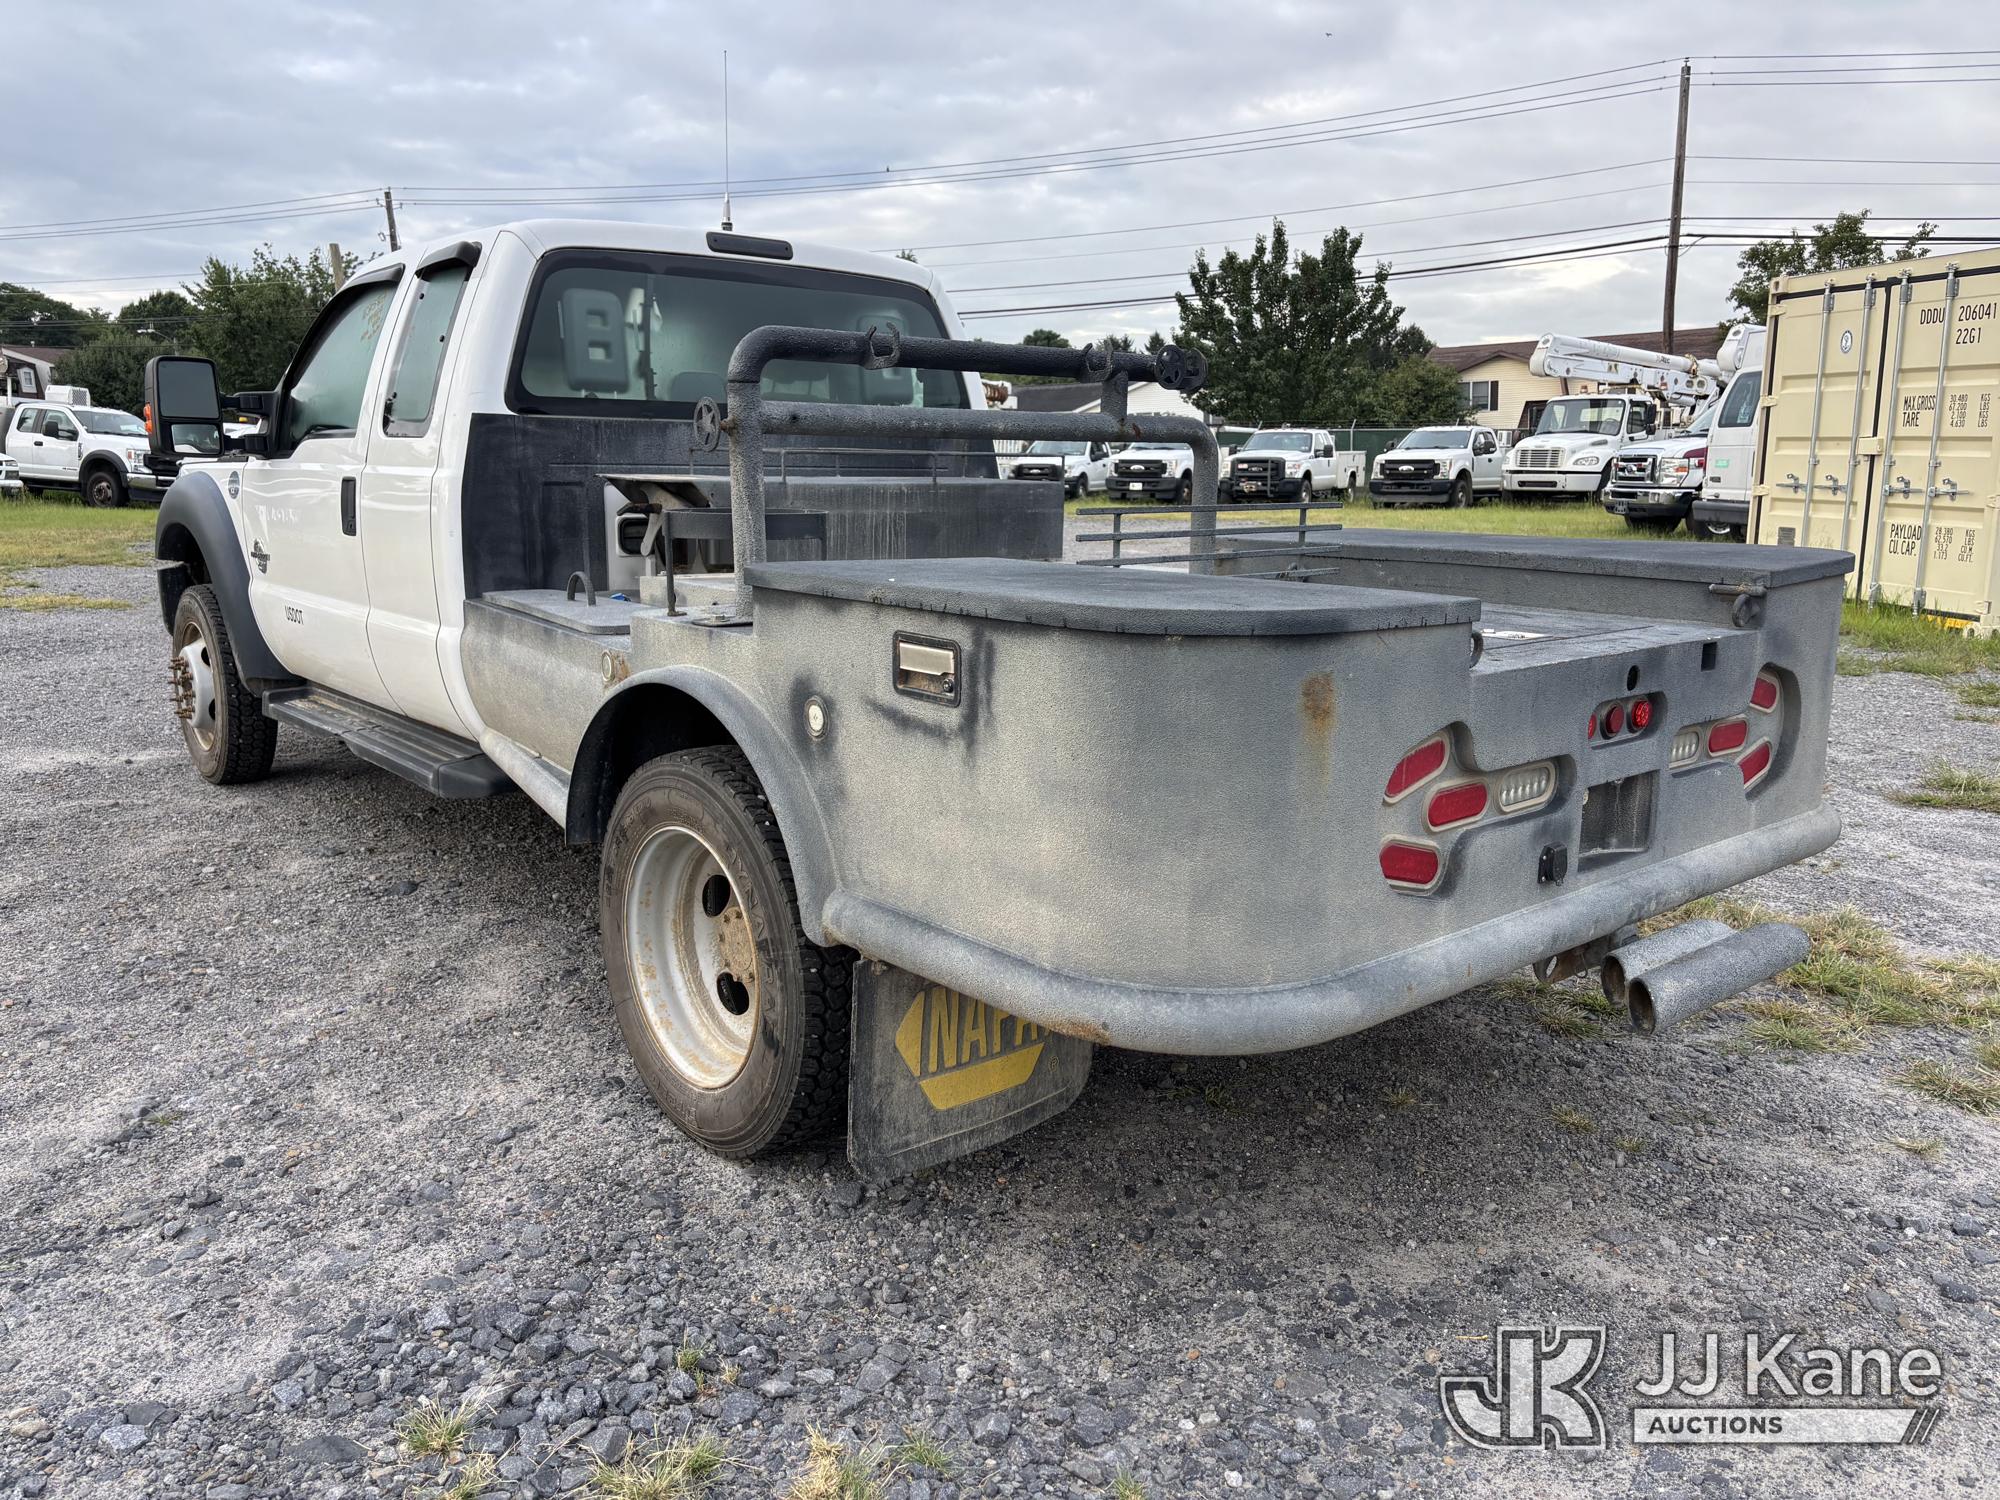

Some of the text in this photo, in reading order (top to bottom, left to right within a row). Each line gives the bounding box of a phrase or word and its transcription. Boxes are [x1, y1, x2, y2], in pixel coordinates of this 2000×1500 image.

[1920, 302, 1997, 325] DDDU 206041
[1955, 327, 1981, 345] 22G1
[1980, 392, 1991, 402] KGS
[1979, 401, 1990, 411] LBS
[1902, 411, 1920, 427] TARE
[1977, 418, 1988, 428] LBS
[1890, 523, 1922, 541] PAYLOAD
[1965, 529, 1976, 538] KGS
[1900, 540, 1916, 556] CAP.
[1964, 537, 1975, 546] LBS
[284, 605, 305, 626] USDOT
